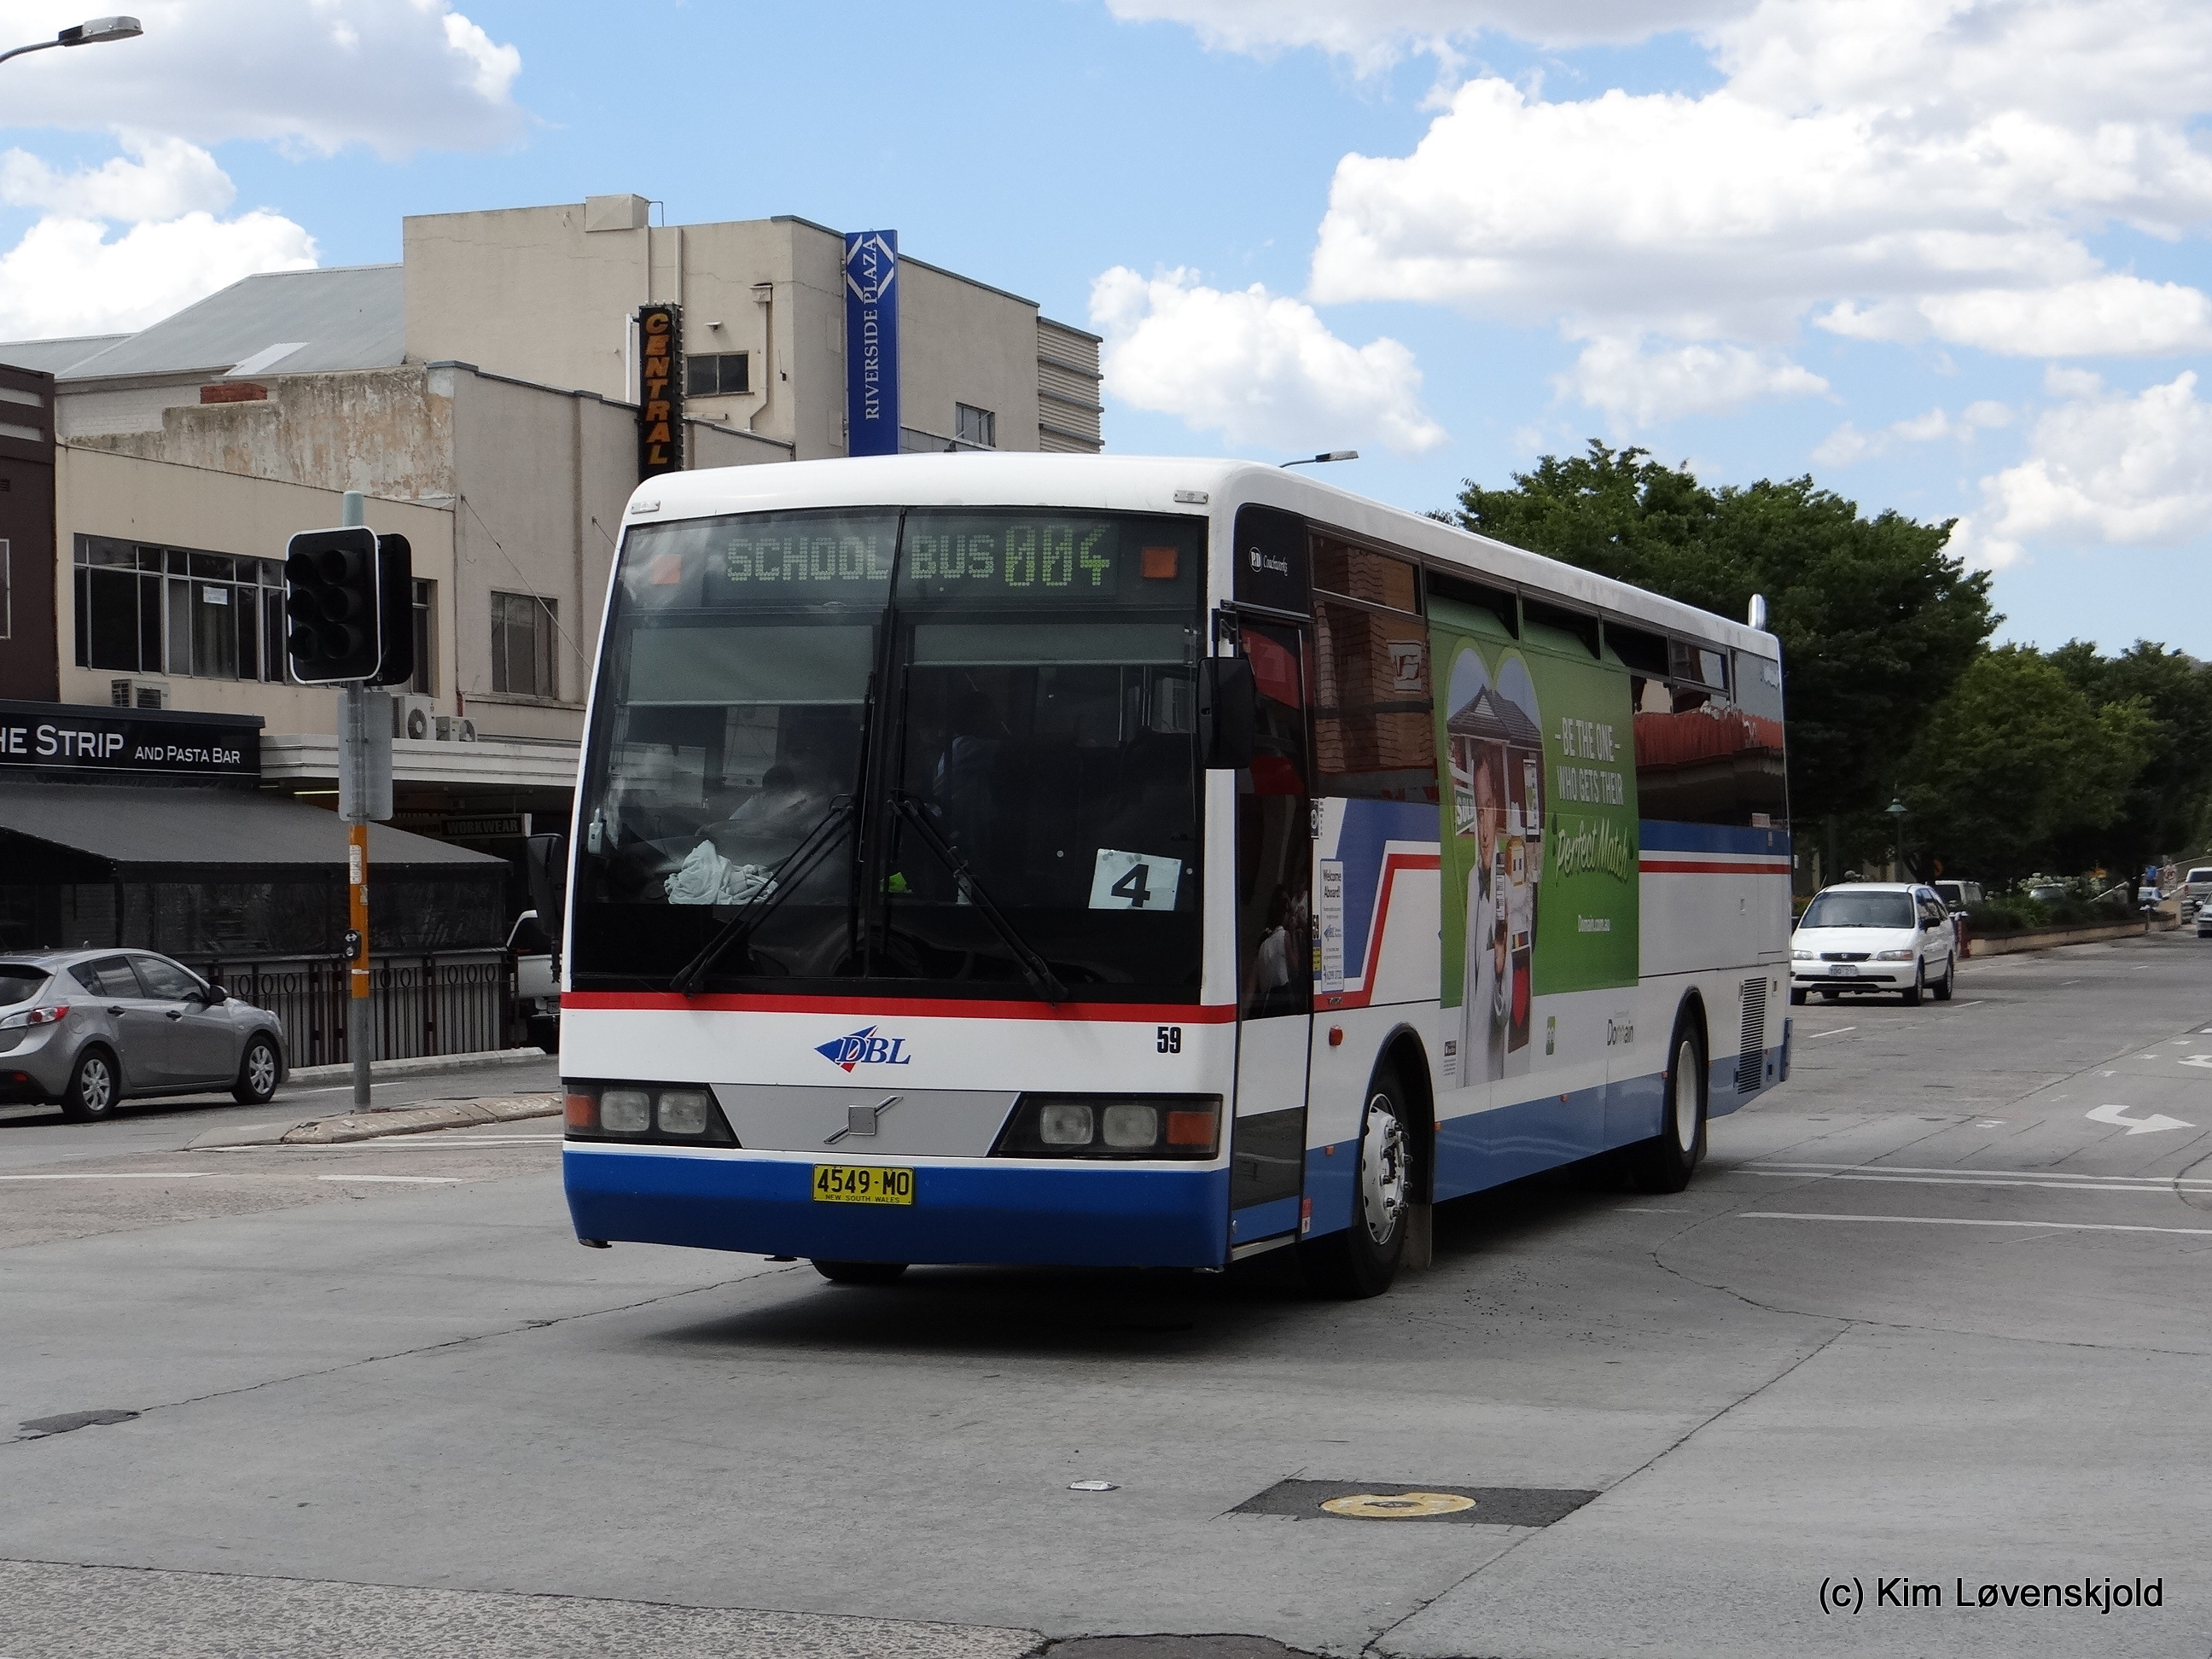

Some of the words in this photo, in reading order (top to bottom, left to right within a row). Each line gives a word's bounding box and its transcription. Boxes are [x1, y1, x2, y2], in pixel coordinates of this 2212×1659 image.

[862, 236, 878, 305] PLAZA
[864, 308, 880, 421] RIVERSIDE
[645, 312, 671, 465] CENTRAL
[727, 536, 888, 582] SCHOOL
[911, 534, 996, 579] BUS
[36, 725, 125, 758] STRIP
[134, 746, 164, 761] AND
[166, 745, 210, 763] PASTA
[212, 748, 241, 765] BAR
[1562, 717, 1575, 757] BE
[1575, 719, 1595, 760] THE
[1596, 723, 1615, 762] ONE
[1557, 765, 1578, 801] WHO
[1578, 767, 1600, 803] GETS
[1600, 771, 1624, 806] THEIR
[446, 819, 519, 835] WORKWEAR
[1556, 819, 1598, 882] Perfect
[1110, 864, 1151, 908] 4
[1322, 869, 1342, 882] Welcome
[835, 1035, 912, 1065] DBL
[1156, 1027, 1182, 1054] 59
[817, 1168, 870, 1194] 4549
